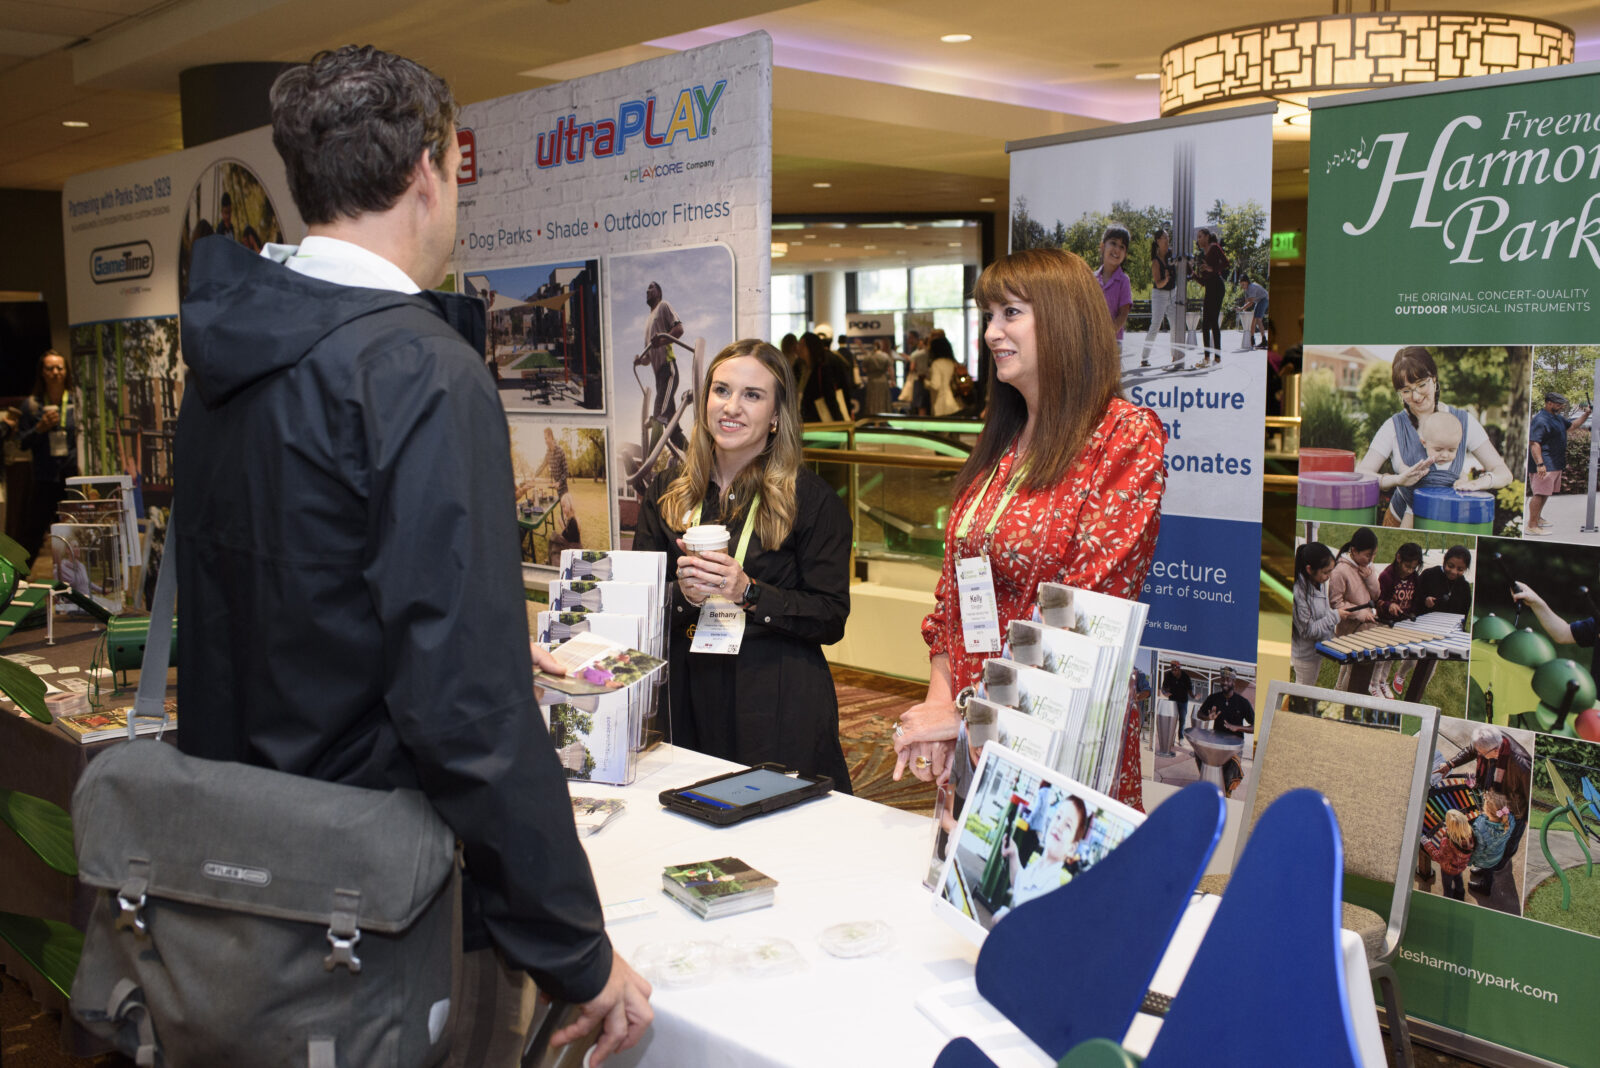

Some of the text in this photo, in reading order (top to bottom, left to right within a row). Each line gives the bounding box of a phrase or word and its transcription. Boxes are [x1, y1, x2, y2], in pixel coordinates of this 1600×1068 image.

[536, 80, 727, 168] ultraPLAY
[630, 162, 683, 183] PLAYCORE
[686, 159, 715, 171] Company
[68, 198, 100, 217] Partnering
[101, 191, 114, 209] with
[115, 188, 133, 206] Parks
[134, 184, 153, 203] Since
[469, 231, 494, 251] Dog
[498, 227, 532, 245] Parks
[546, 219, 589, 240] Shade
[604, 209, 667, 233] Outdoor
[673, 200, 730, 223] Fitness
[1442, 192, 1600, 270] Park
[94, 251, 149, 276] GameTime
[1398, 288, 1589, 303] THE ORIGINAL CONCERT-QUALITY
[1395, 302, 1591, 315] OUTDOOR MUSICAL INSTRUMENTS
[1131, 386, 1245, 412] Sculpture
[1163, 419, 1181, 439] at
[1164, 453, 1251, 476] sonates
[1146, 560, 1227, 584] ecture
[1155, 584, 1173, 596] art
[1177, 585, 1189, 598] of
[1193, 588, 1236, 604] sound.
[1145, 619, 1187, 632] Park Brand
[1399, 945, 1558, 1004] tesharmonypark.com
